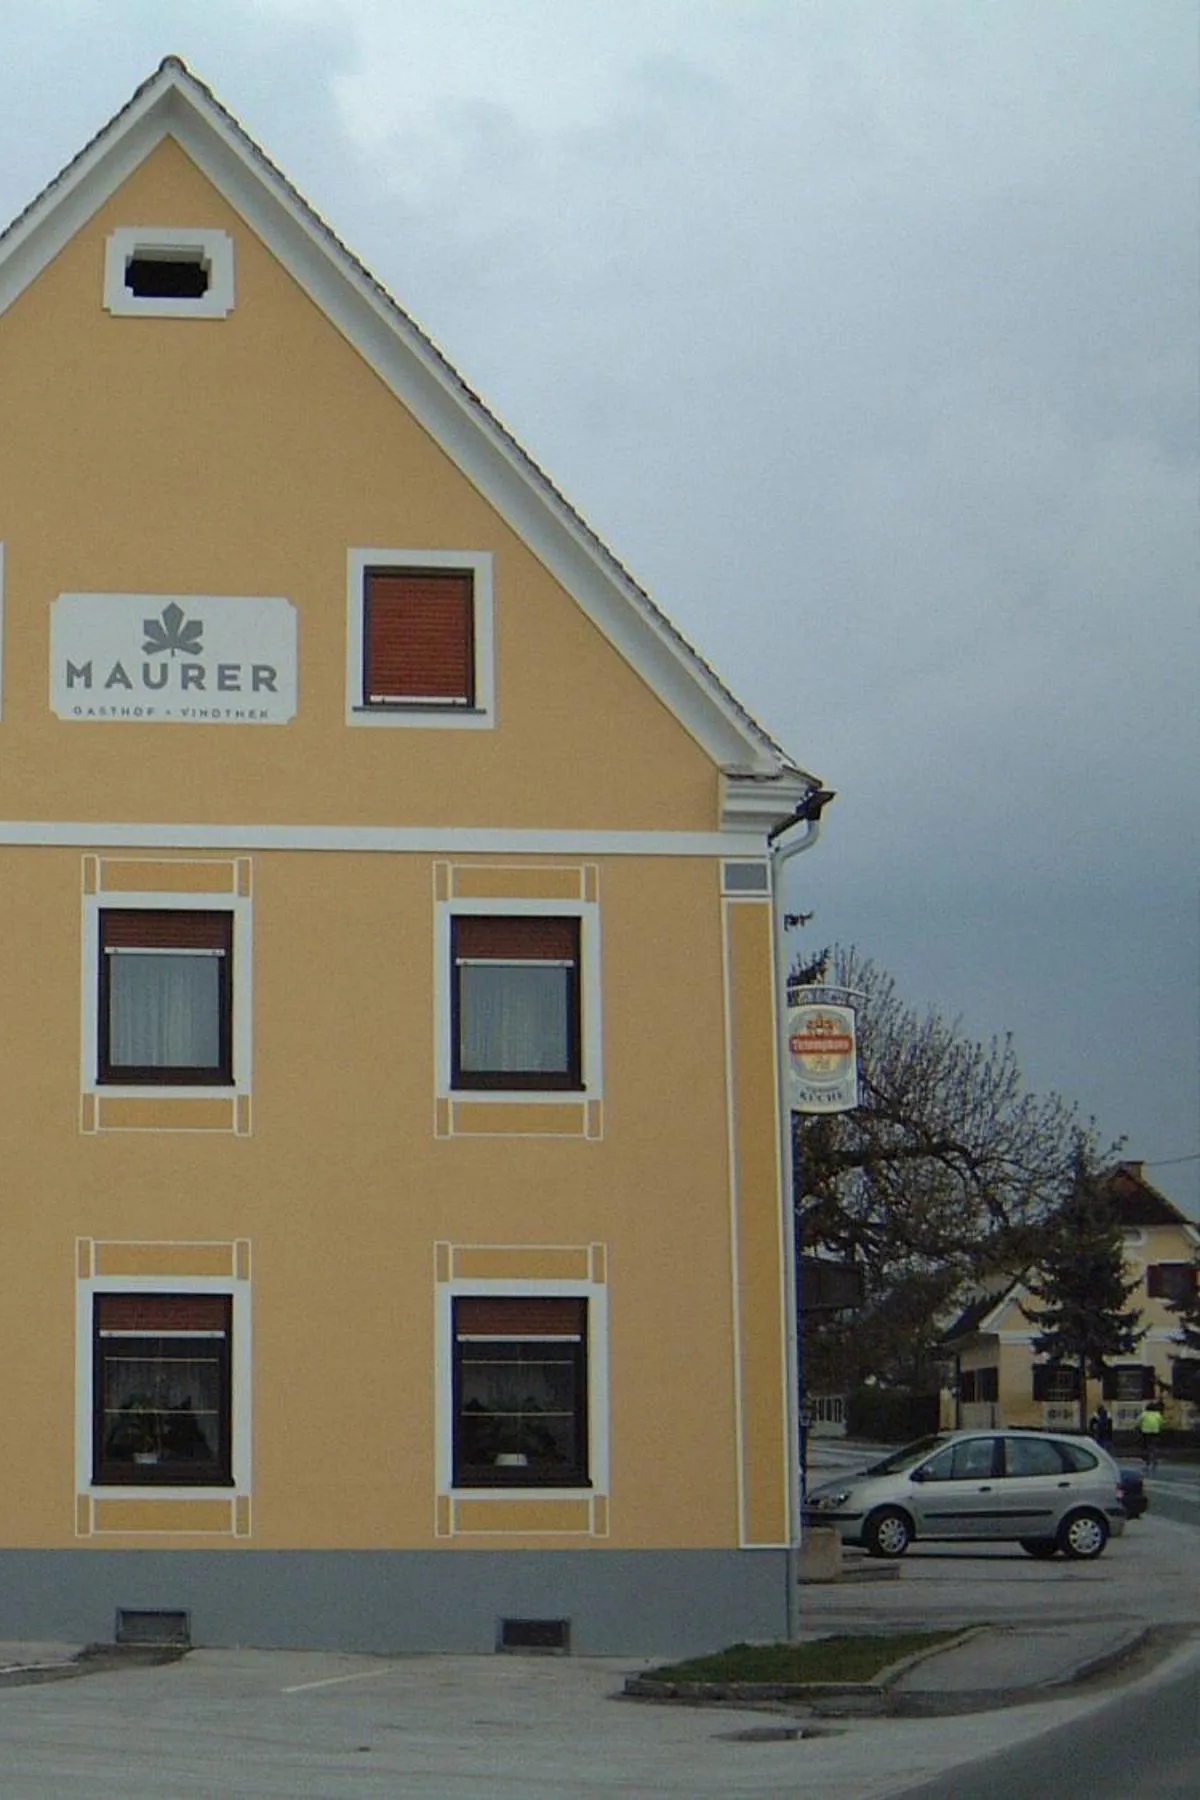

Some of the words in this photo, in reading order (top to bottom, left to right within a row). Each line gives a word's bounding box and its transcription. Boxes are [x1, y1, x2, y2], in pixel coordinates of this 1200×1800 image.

[66, 660, 278, 692] MAURER
[73, 706, 155, 717] GASTHOF
[181, 707, 269, 719] VINOTHEK
